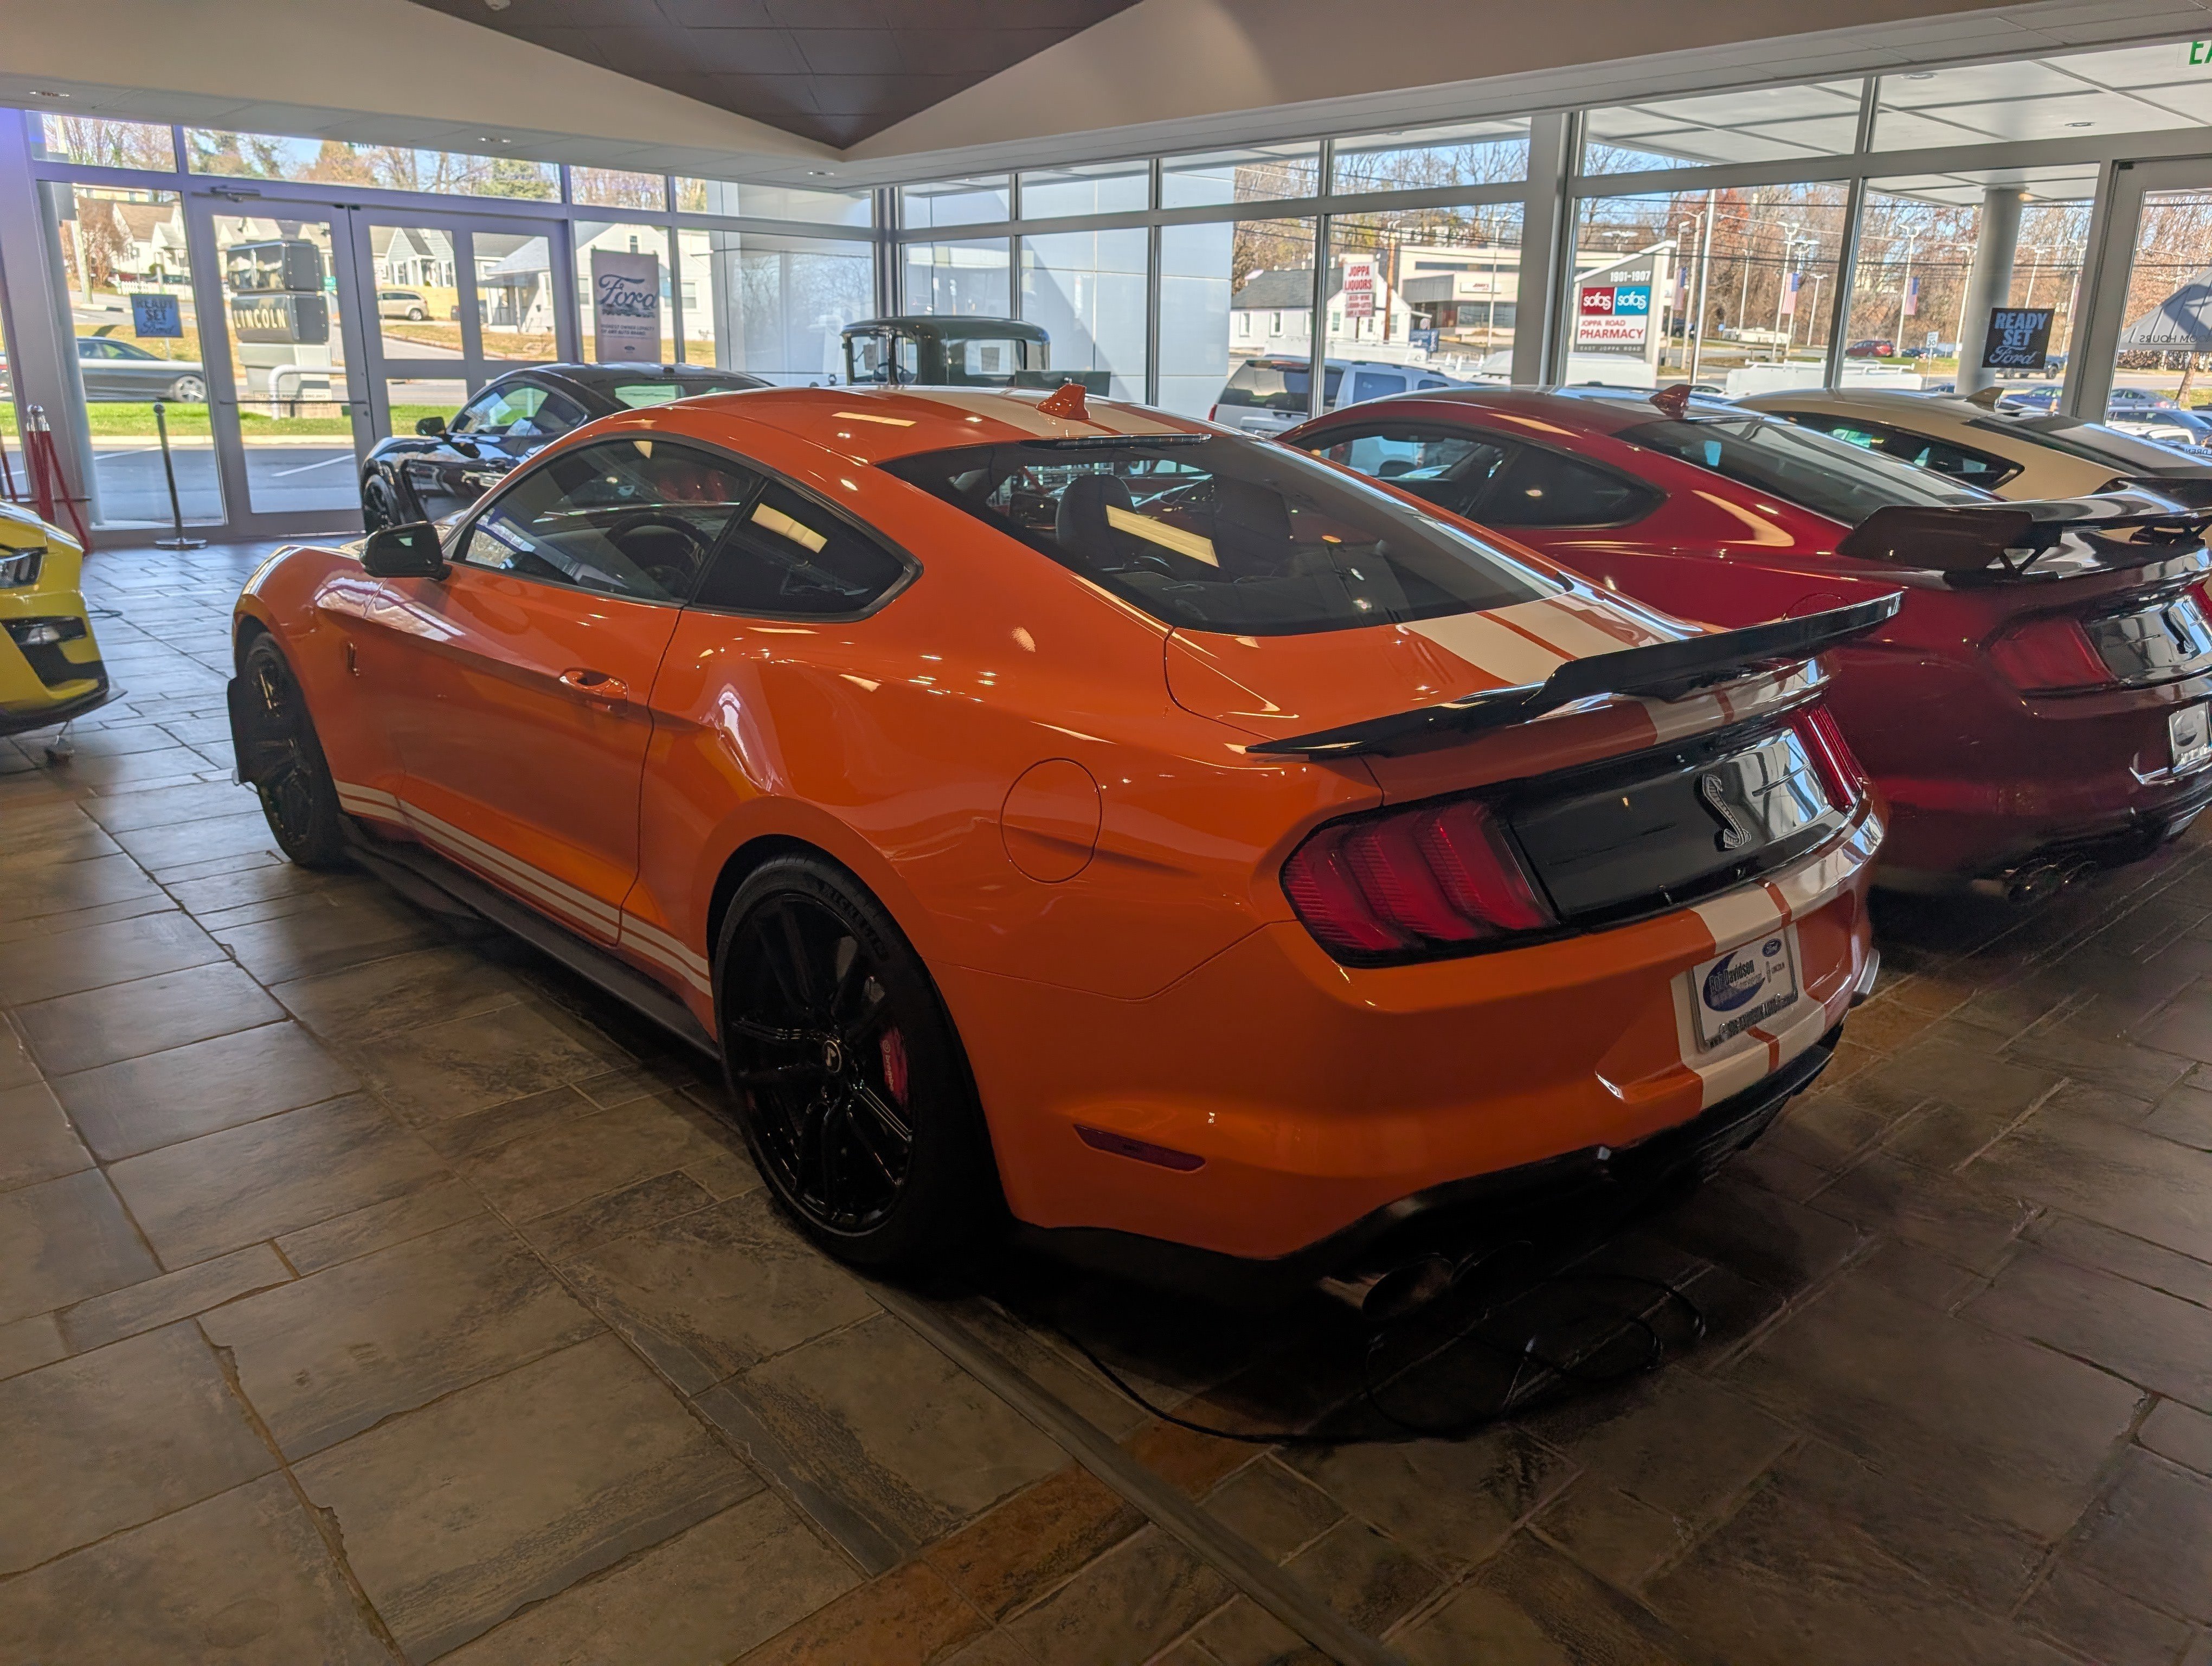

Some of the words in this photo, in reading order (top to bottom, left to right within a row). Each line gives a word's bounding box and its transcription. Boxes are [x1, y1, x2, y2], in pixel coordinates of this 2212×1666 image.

[1348, 266, 1369, 277] JOPPA
[1610, 270, 1651, 283] 1901-1907
[1345, 279, 1372, 291] LIQUORS
[233, 308, 286, 329] LINCOLN
[1995, 312, 2048, 330] READY
[1580, 329, 1643, 339] PHARMACY
[2002, 329, 2033, 346] SET
[1989, 345, 2041, 364] Ford
